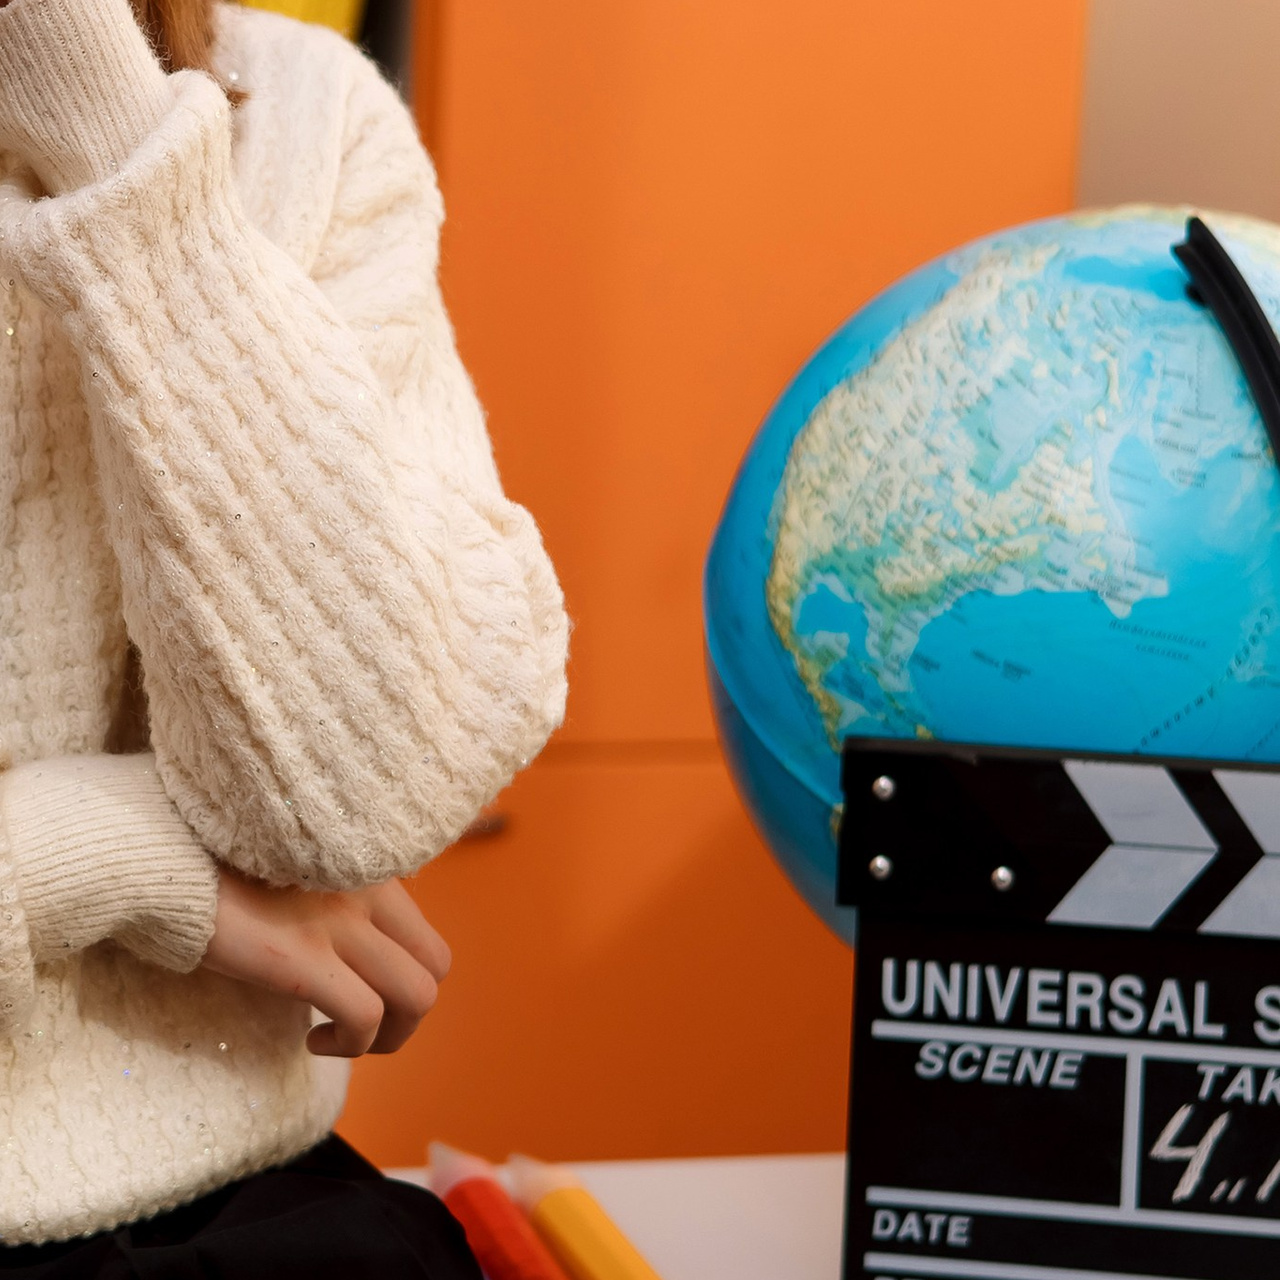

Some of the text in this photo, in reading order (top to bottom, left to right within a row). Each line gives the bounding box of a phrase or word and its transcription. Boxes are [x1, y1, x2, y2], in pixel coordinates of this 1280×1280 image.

[881, 957, 1226, 1040] UNIVERSAL
[914, 1041, 1085, 1089] SCENE
[871, 1208, 972, 1246] DATE
